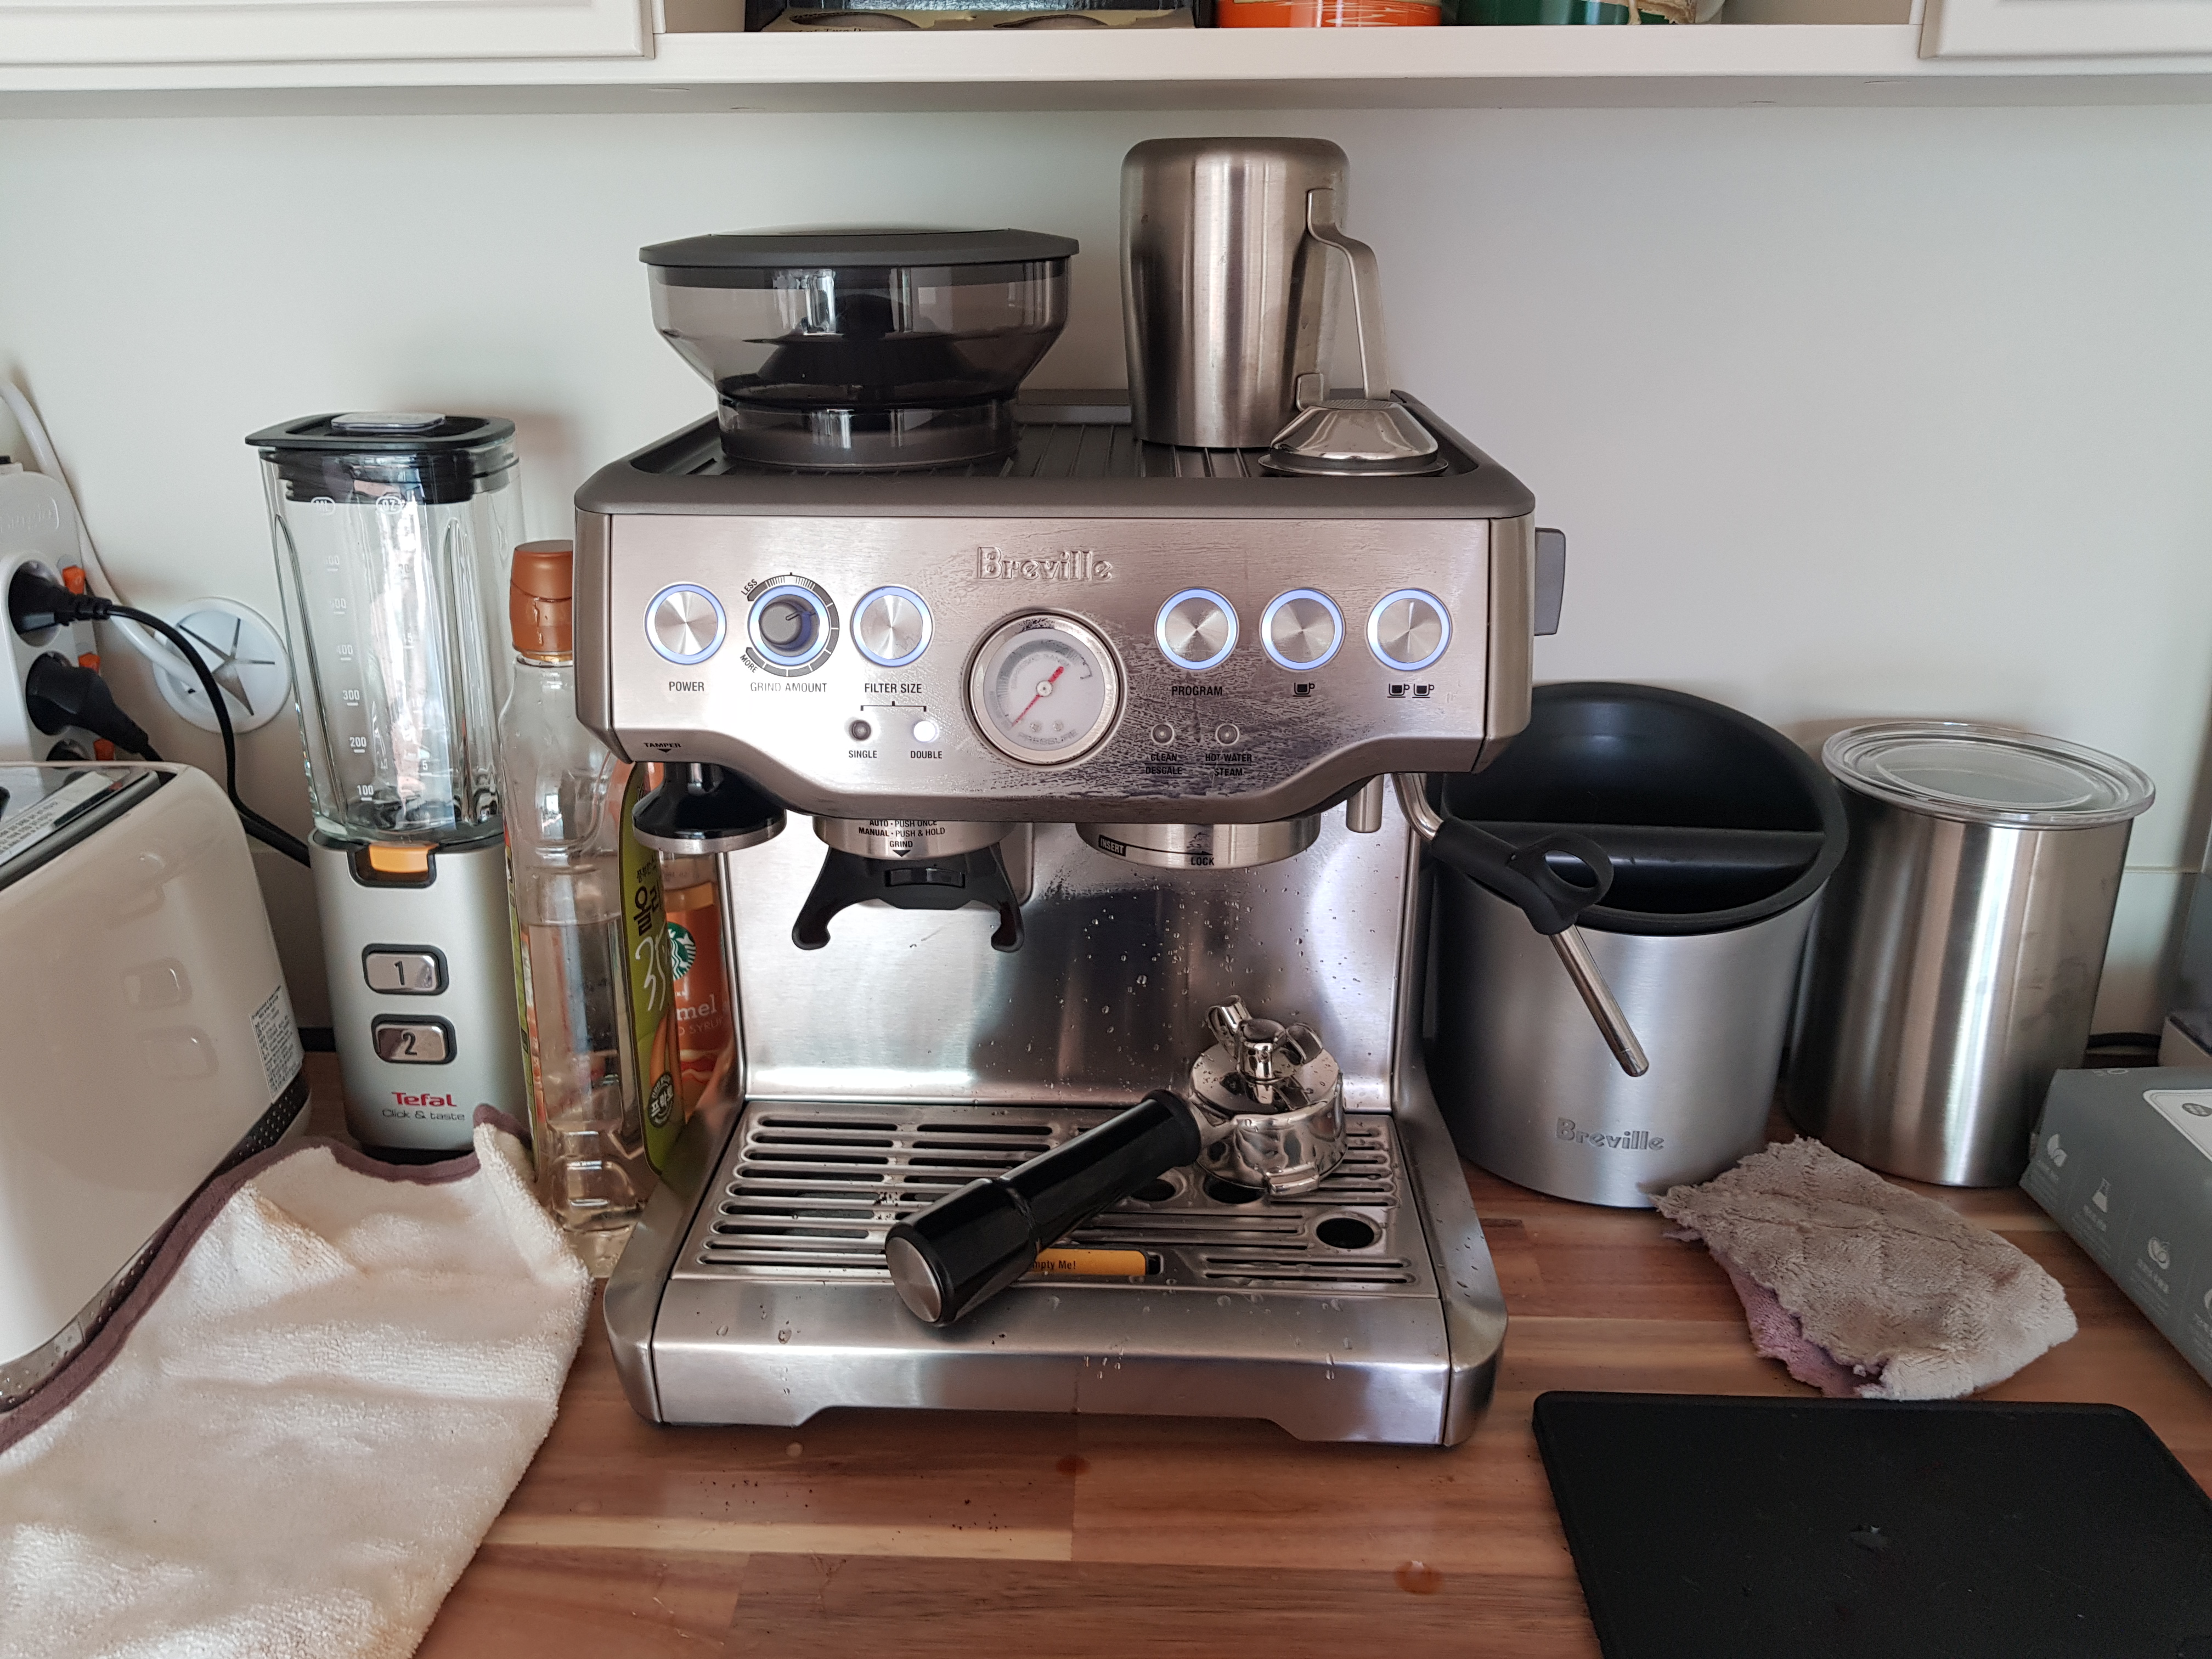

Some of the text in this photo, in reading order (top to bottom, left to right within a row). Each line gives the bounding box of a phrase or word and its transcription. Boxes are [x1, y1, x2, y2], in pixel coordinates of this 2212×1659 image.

[382, 500, 396, 512] OZ
[977, 547, 1112, 580] Breville
[741, 579, 758, 596] LESS
[740, 654, 758, 674] MORE
[668, 681, 704, 691] POWER
[751, 682, 827, 692] GRIND AMOUNT
[864, 683, 922, 693] FILTER SIZE
[1171, 686, 1223, 696] PROGRAM
[343, 690, 360, 700] 300
[349, 737, 367, 747] 200
[848, 750, 878, 759] SINGLE
[910, 751, 943, 759] DOUBLE
[1150, 753, 1177, 762] CLEAN
[1205, 753, 1252, 762] HOT WATER
[1146, 766, 1182, 775] DESCALE
[1214, 768, 1243, 776] STEAM
[357, 785, 374, 795] 100
[858, 827, 890, 837] MANUAL
[926, 827, 945, 836] HOLD
[1100, 837, 1124, 854] INSERT
[1190, 857, 1215, 866] LOCK
[394, 961, 405, 985] 1
[676, 994, 718, 1021] mel
[402, 1032, 417, 1056] 2
[391, 1092, 457, 1107] Tefal
[382, 1109, 465, 1120] Click & taste
[1556, 1117, 1665, 1151] Breville
[1032, 1260, 1076, 1270] mpty Me!
